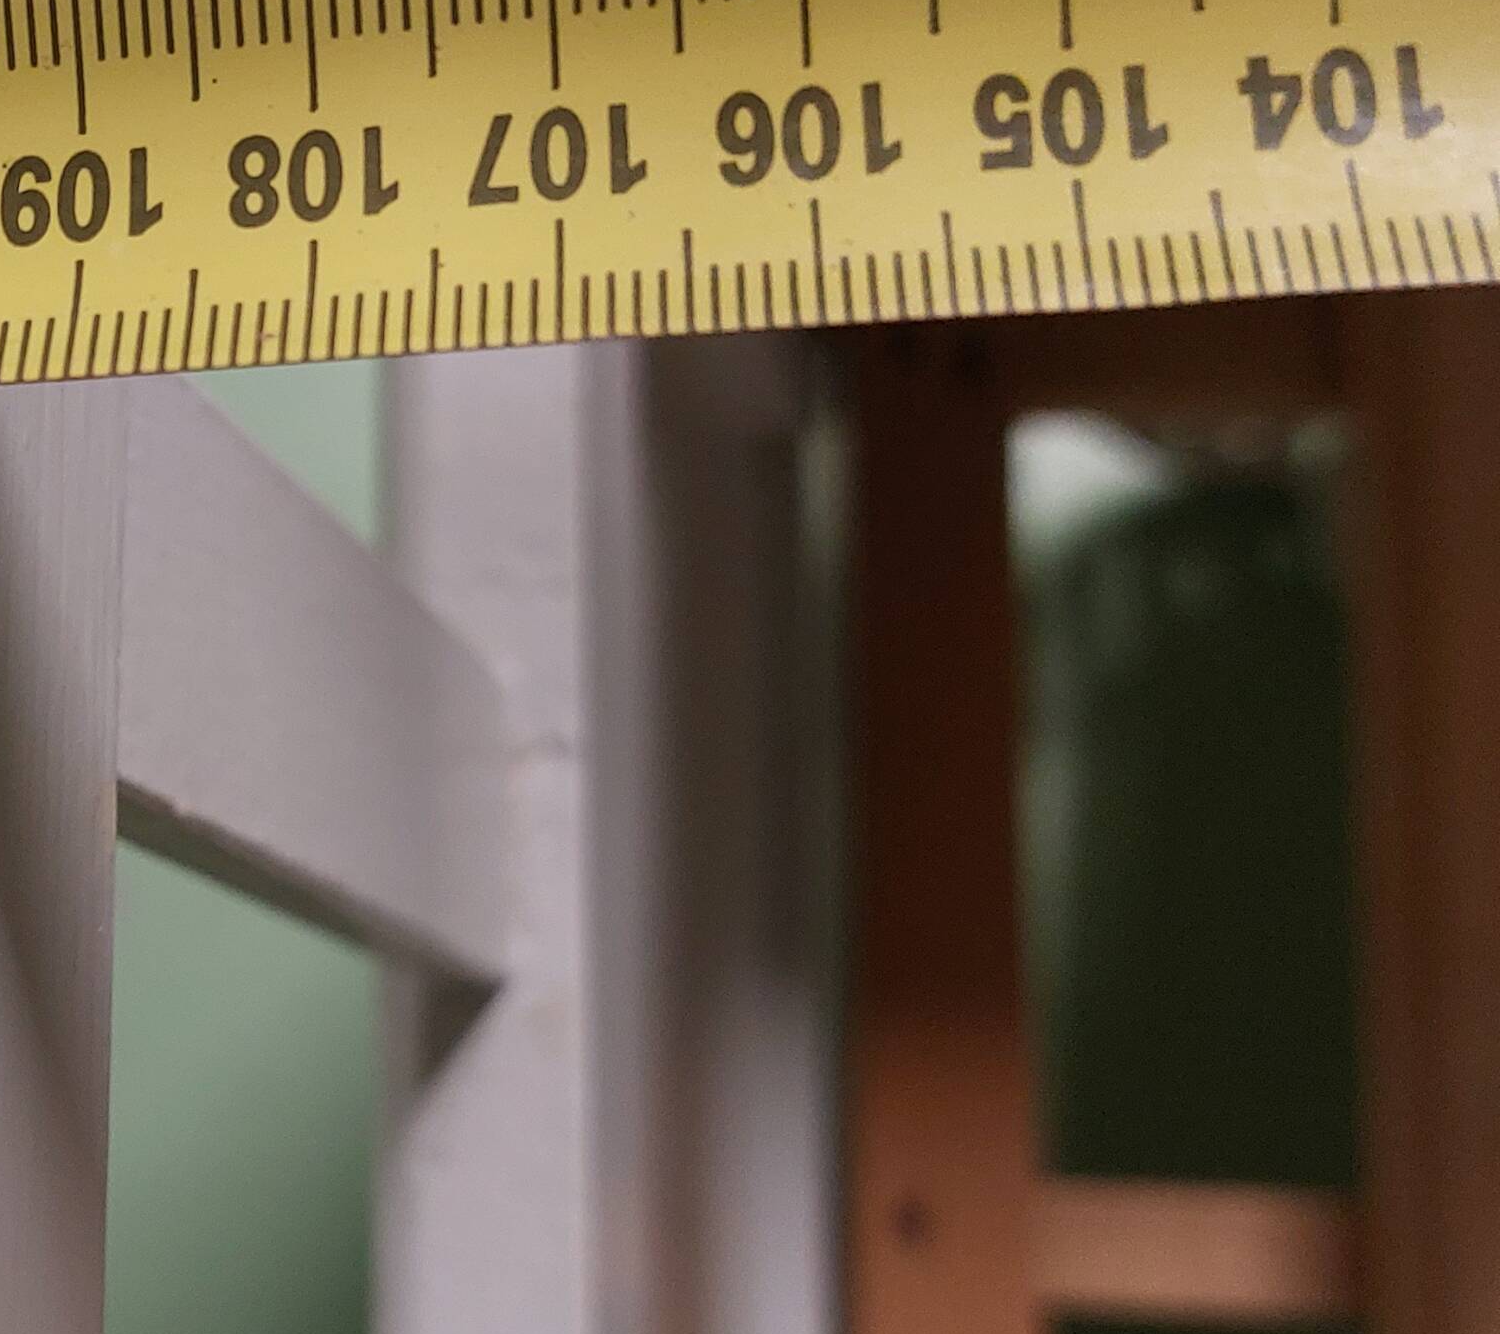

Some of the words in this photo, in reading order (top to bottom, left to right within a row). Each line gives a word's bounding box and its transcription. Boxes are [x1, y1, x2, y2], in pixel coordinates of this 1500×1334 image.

[715, 79, 903, 187] 106
[972, 63, 1170, 171] 105
[1236, 42, 1444, 151] 104
[0, 146, 165, 248] 109
[227, 125, 401, 229] 108
[467, 101, 649, 207] 107
